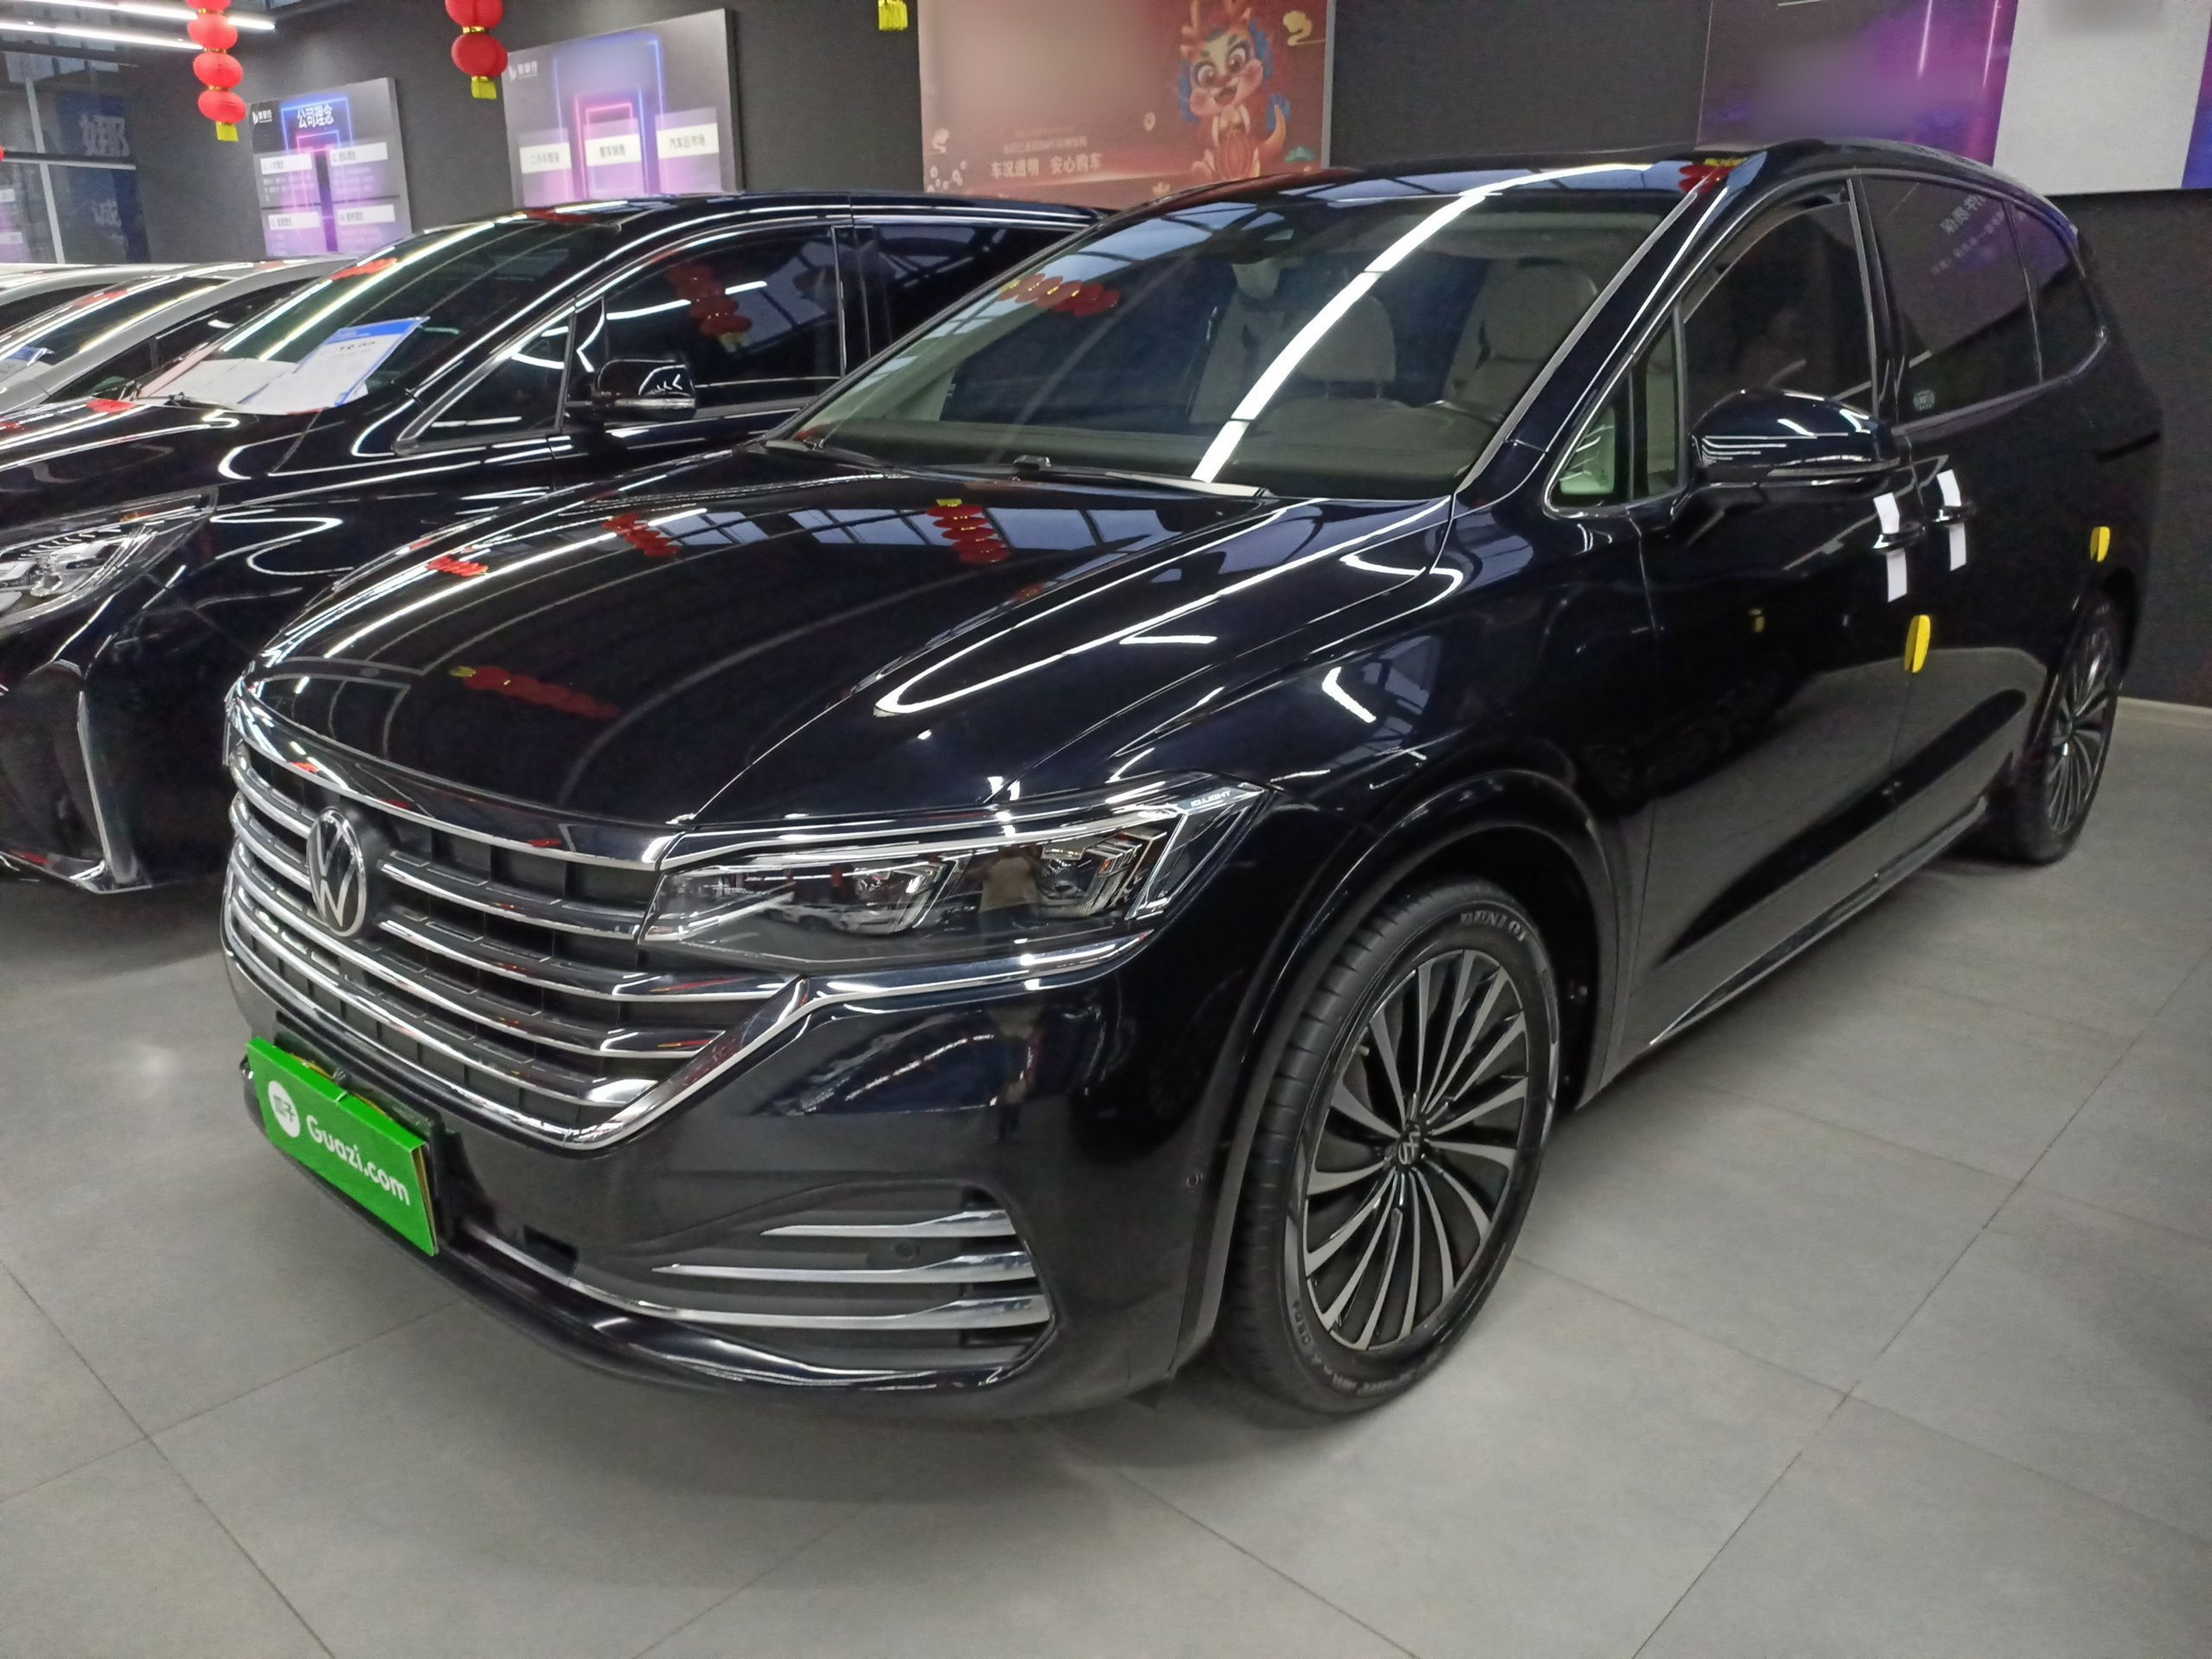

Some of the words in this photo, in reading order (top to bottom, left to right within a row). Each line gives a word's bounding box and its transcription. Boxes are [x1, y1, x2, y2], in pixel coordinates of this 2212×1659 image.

[297, 103, 335, 129] 公司理念
[990, 158, 1039, 180] 车况透明
[1050, 152, 1101, 175] 安心购车
[306, 1115, 411, 1206] Guazi.com
